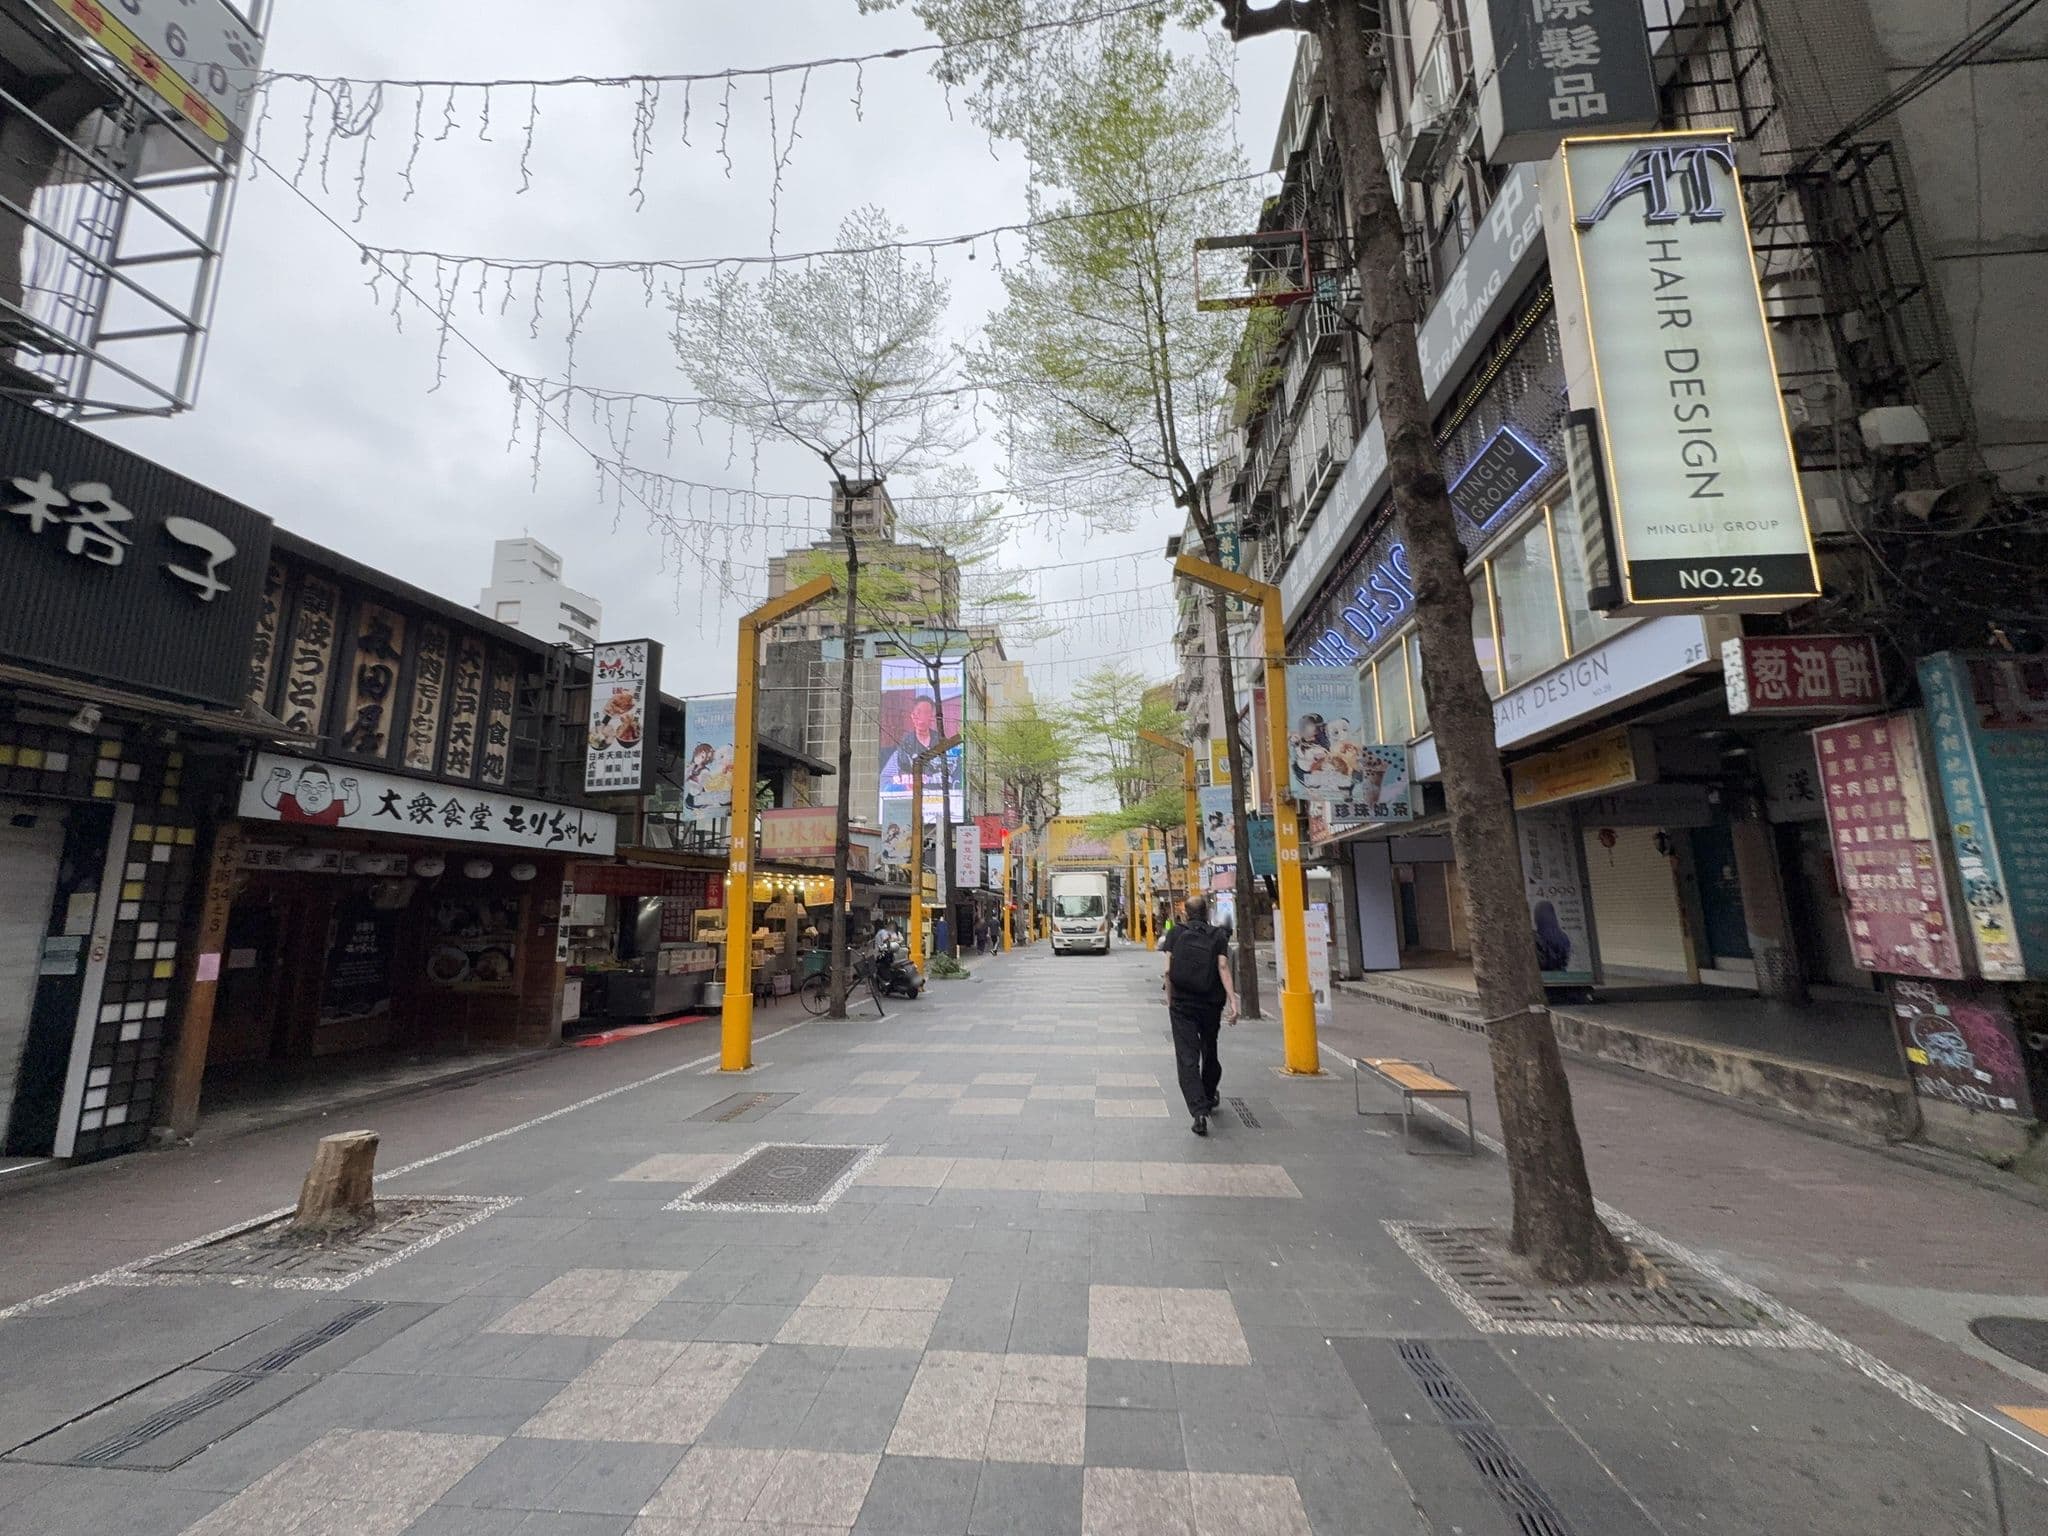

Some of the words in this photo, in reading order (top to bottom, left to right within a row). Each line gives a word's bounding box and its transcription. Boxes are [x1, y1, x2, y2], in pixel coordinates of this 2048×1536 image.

[1646, 239, 1693, 331] HAIR
[1431, 269, 1502, 381] TRAINING
[1663, 347, 1725, 499] DESIGN
[1454, 438, 1516, 507] MINGLIU
[1470, 467, 1519, 519] GROUP
[7, 470, 237, 602] 格子
[1646, 521, 1714, 536] MINGLIU
[1723, 519, 1780, 533] GROUP
[1679, 566, 1763, 590] NO.26
[1533, 651, 1610, 710] DESIGN
[1683, 645, 1705, 666] 2F
[1280, 848, 1298, 861] 09
[1282, 823, 1294, 836] H
